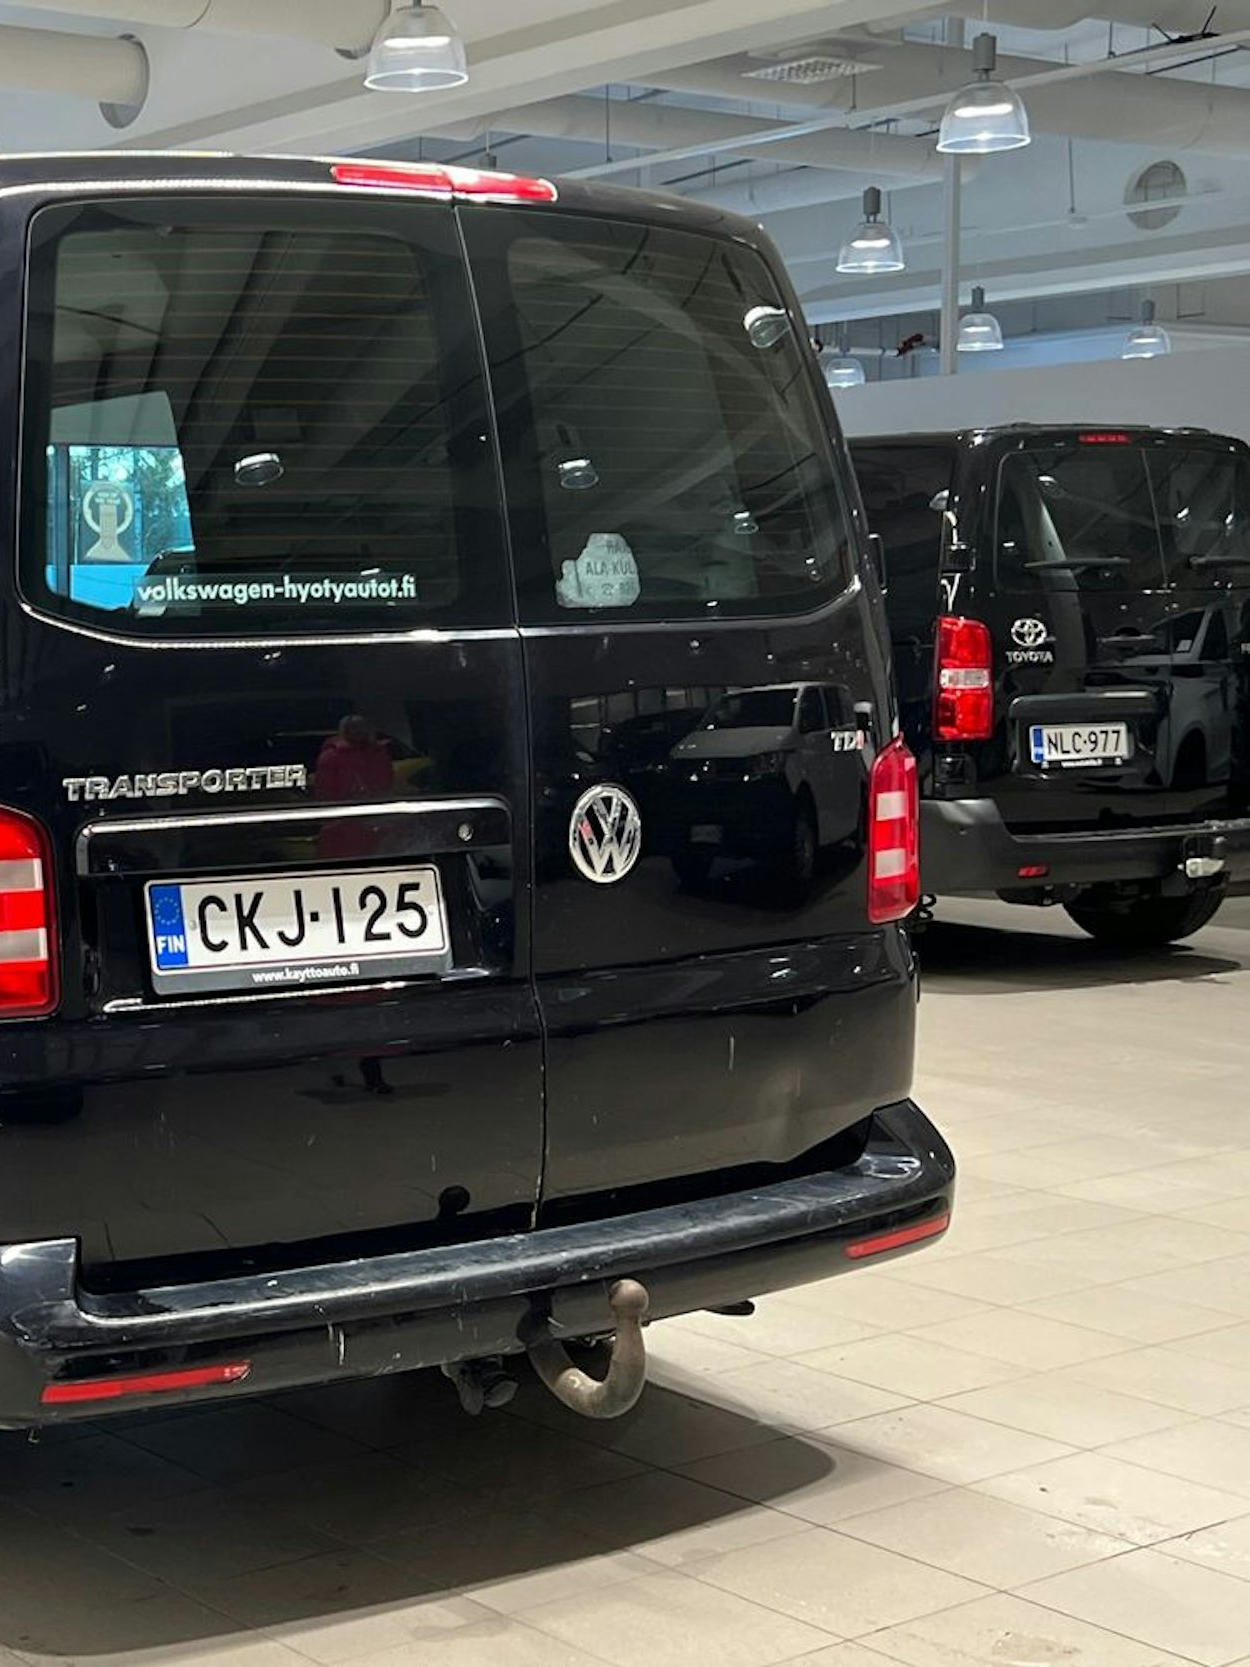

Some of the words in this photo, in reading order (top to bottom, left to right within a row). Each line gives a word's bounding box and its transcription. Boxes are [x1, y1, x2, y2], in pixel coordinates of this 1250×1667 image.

[137, 574, 416, 605] volkswagen-hyotyautot.fi
[1005, 650, 1054, 663] TOYOTA
[830, 729, 865, 752] TDI
[1046, 730, 1122, 756] NLC-977
[62, 764, 307, 802] TRANSPORTER
[197, 881, 429, 953] CKJ-125
[155, 933, 187, 956] FIN
[251, 962, 360, 983] www.kayttoauto.fi
